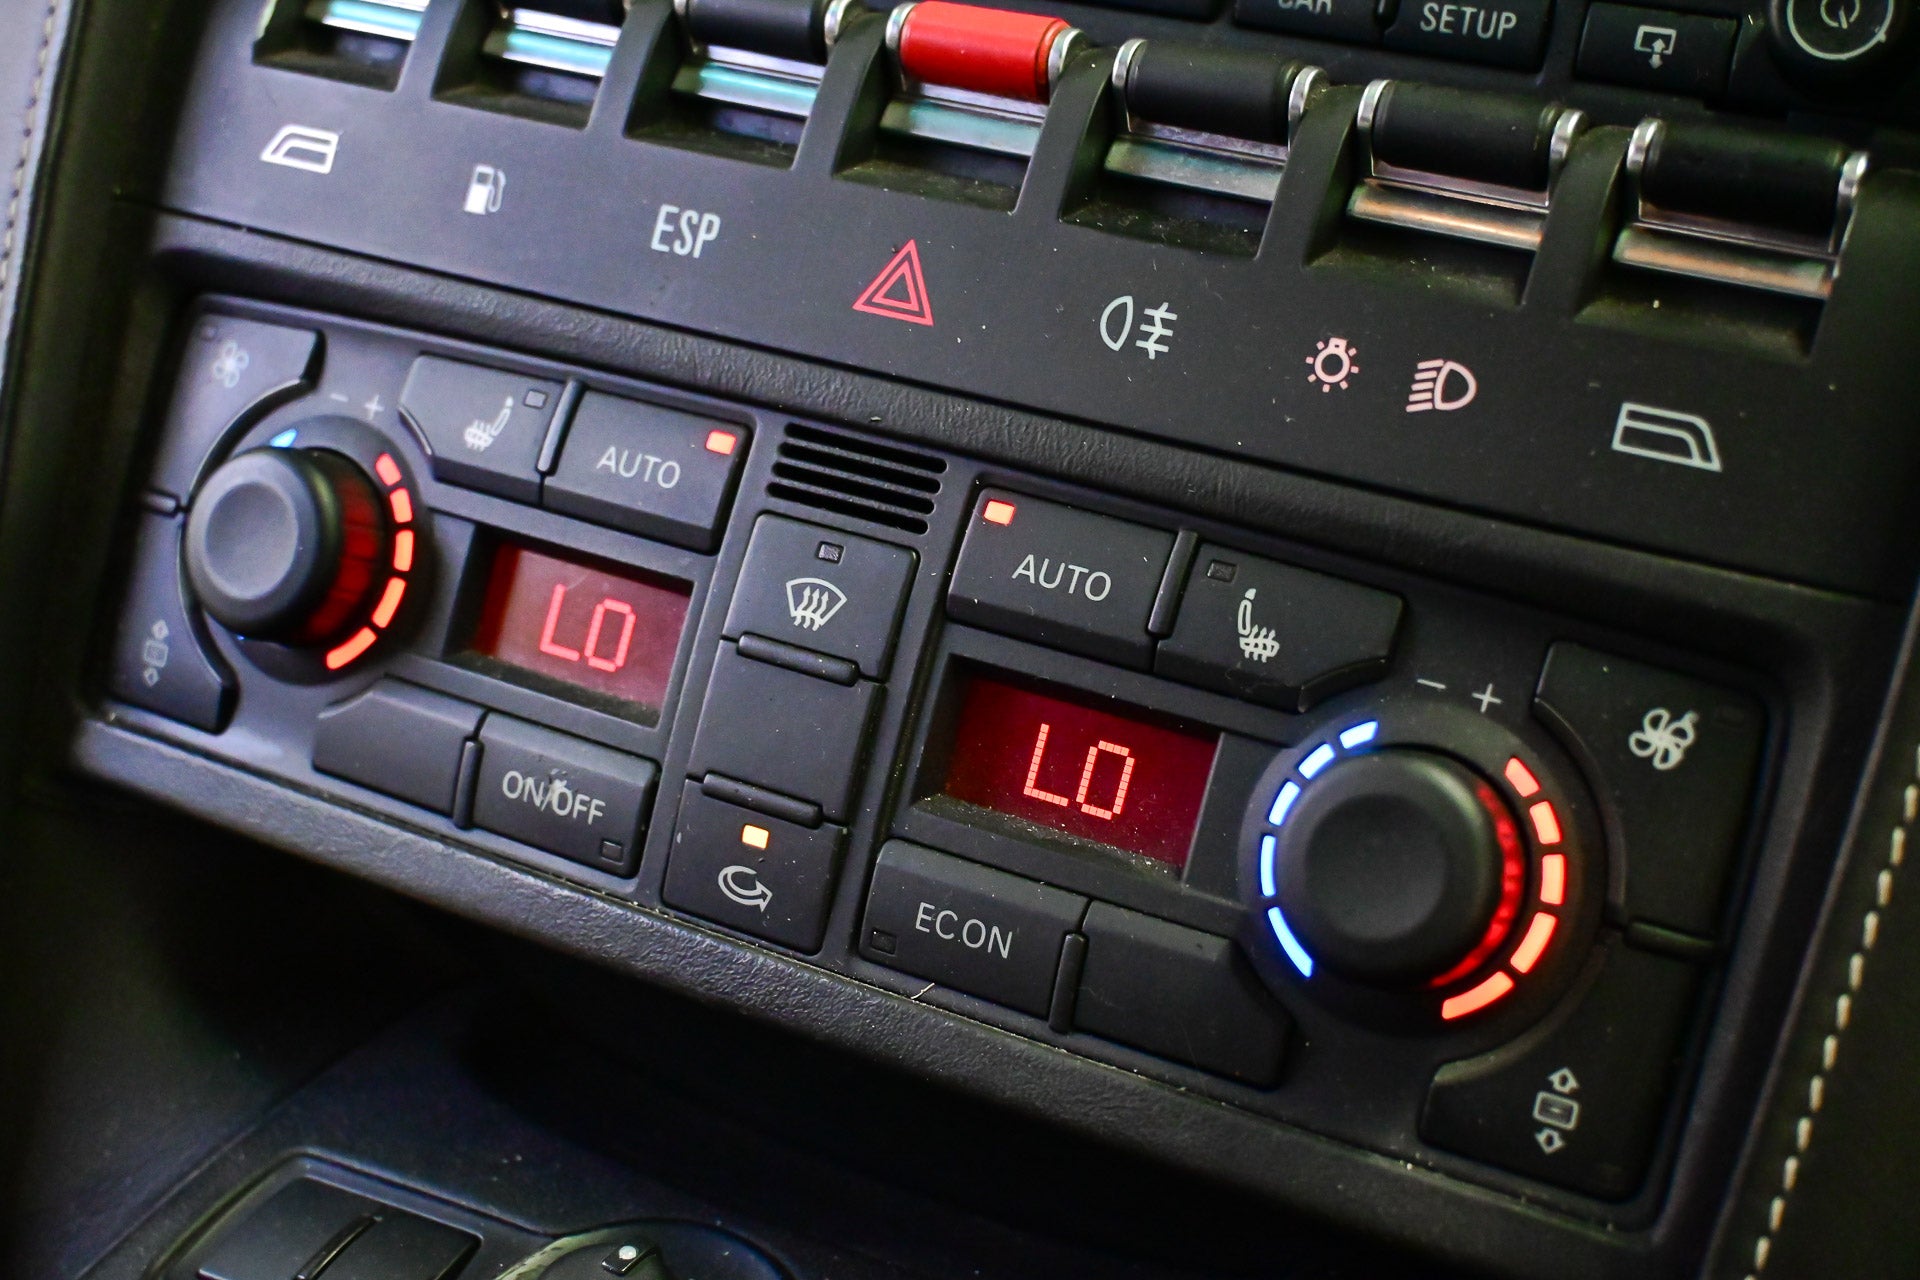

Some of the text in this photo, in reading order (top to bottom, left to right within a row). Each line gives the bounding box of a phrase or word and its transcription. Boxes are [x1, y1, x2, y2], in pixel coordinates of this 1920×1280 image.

[1420, 2, 1517, 40] SETUP
[651, 204, 721, 258] ESP
[597, 445, 680, 488] AUTO
[1012, 554, 1111, 601] AUTO
[539, 584, 636, 672] LO
[502, 770, 606, 825] ON/OFF
[1023, 723, 1135, 819] LO
[915, 902, 1013, 959] ECON
